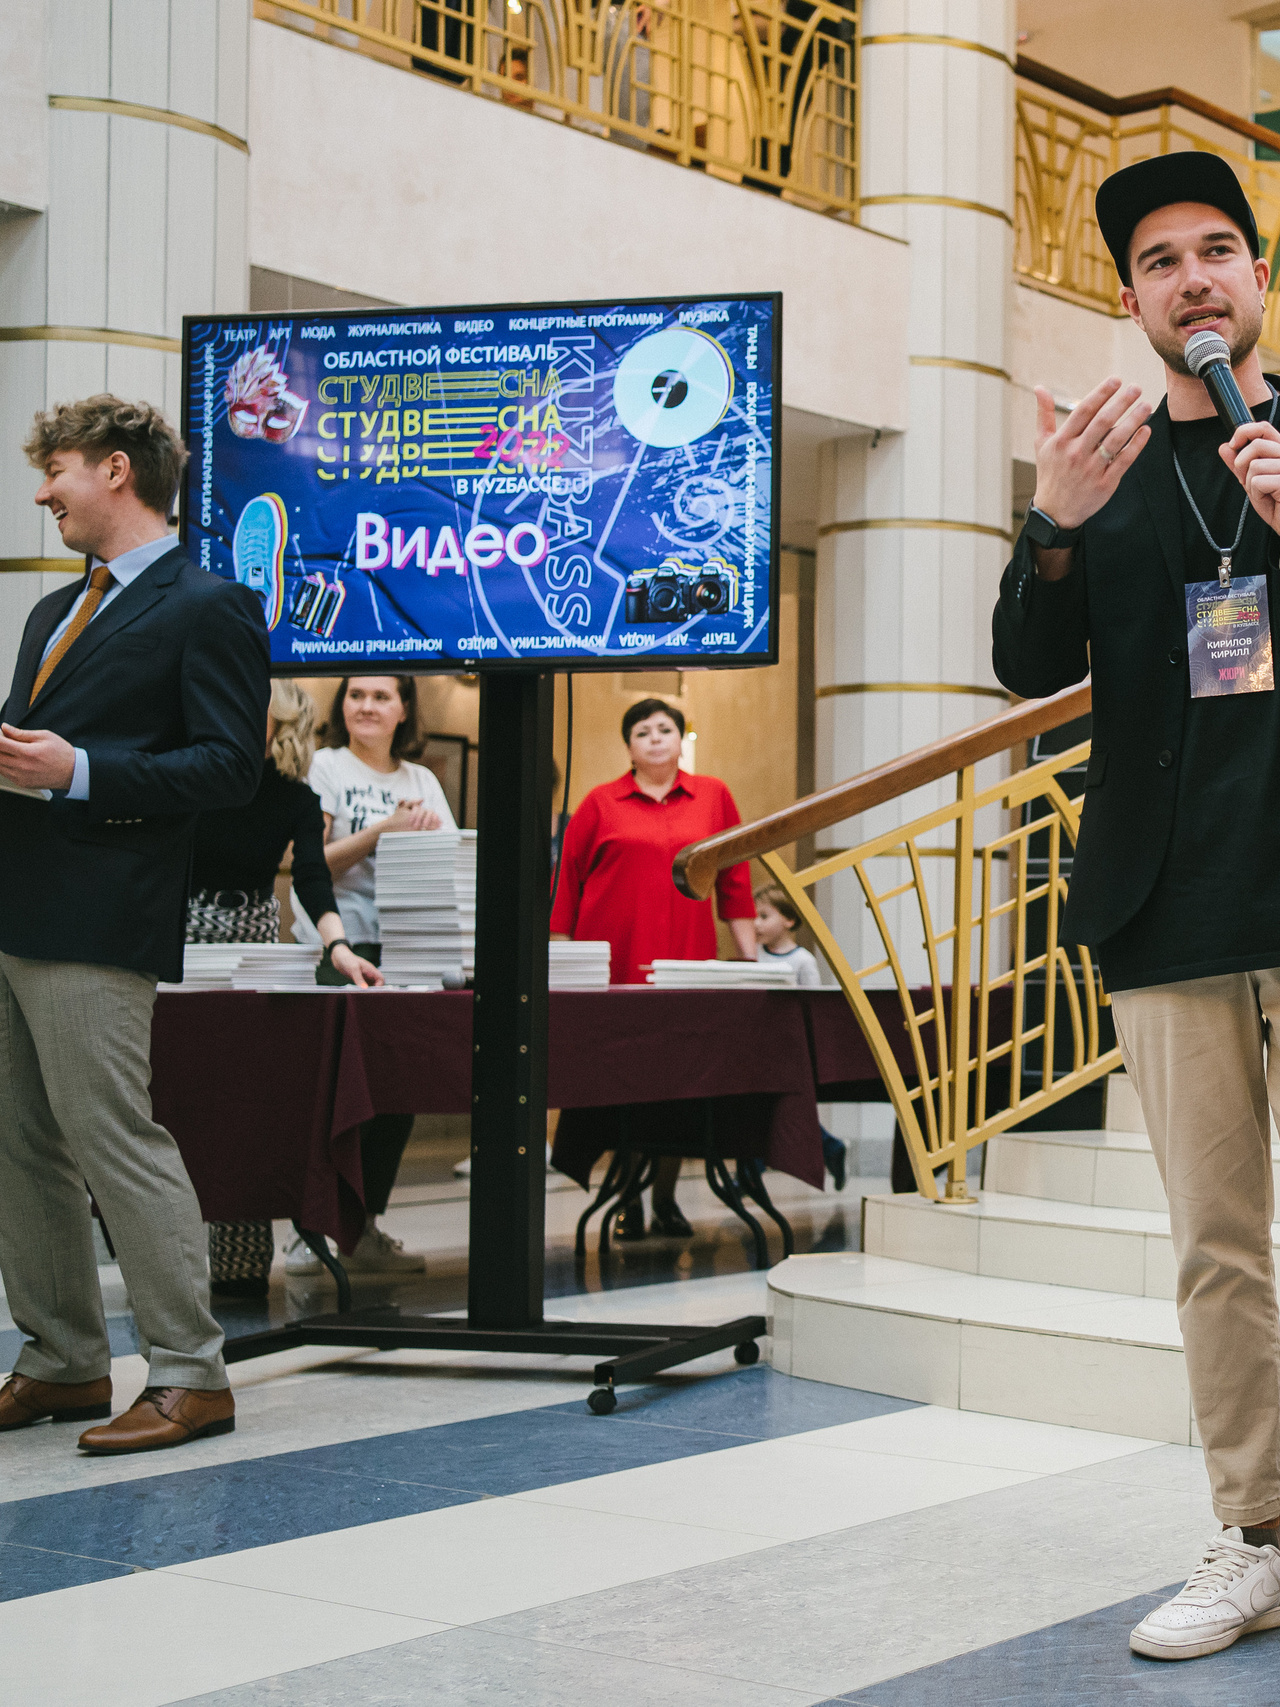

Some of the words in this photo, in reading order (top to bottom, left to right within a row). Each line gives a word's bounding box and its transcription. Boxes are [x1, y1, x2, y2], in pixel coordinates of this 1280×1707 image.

[223, 328, 257, 342] ТЕАТР
[269, 327, 291, 340] АРТ
[301, 325, 336, 340] МОДА
[348, 321, 442, 337] ЖУРНАЛИСТИКА
[454, 320, 494, 335] ВИДЕО
[509, 315, 587, 331] КОНЦЕРТНЫЕ
[588, 313, 663, 328] ПРОГРАММЫ
[679, 310, 729, 324] МУЗЫКА
[746, 324, 758, 370] ТАНЦЫ
[324, 345, 441, 369] ОБЛАСТНОЙ
[445, 344, 559, 367] ФЕСТИВАЛЬ
[745, 382, 758, 427] ВОКАЛ
[472, 424, 571, 468] 2022
[456, 478, 469, 496] В
[545, 335, 595, 629] KUZBASS
[356, 512, 549, 577] Видео
[366, 637, 443, 652] КОНЦЕРТНЫЕ
[457, 635, 497, 650] ВИДЕО
[510, 634, 606, 649] ЖУРНАЛИСТИКА
[619, 632, 656, 647] МОДА
[665, 633, 689, 646] АРТ
[702, 632, 737, 645] ТЕАТР
[1207, 637, 1253, 650] КИРИЛОВ
[291, 640, 363, 654] ПРОГРАММЫ
[1211, 648, 1250, 660] КИРИЛЛ
[1218, 666, 1246, 681] ЖЮРИ
